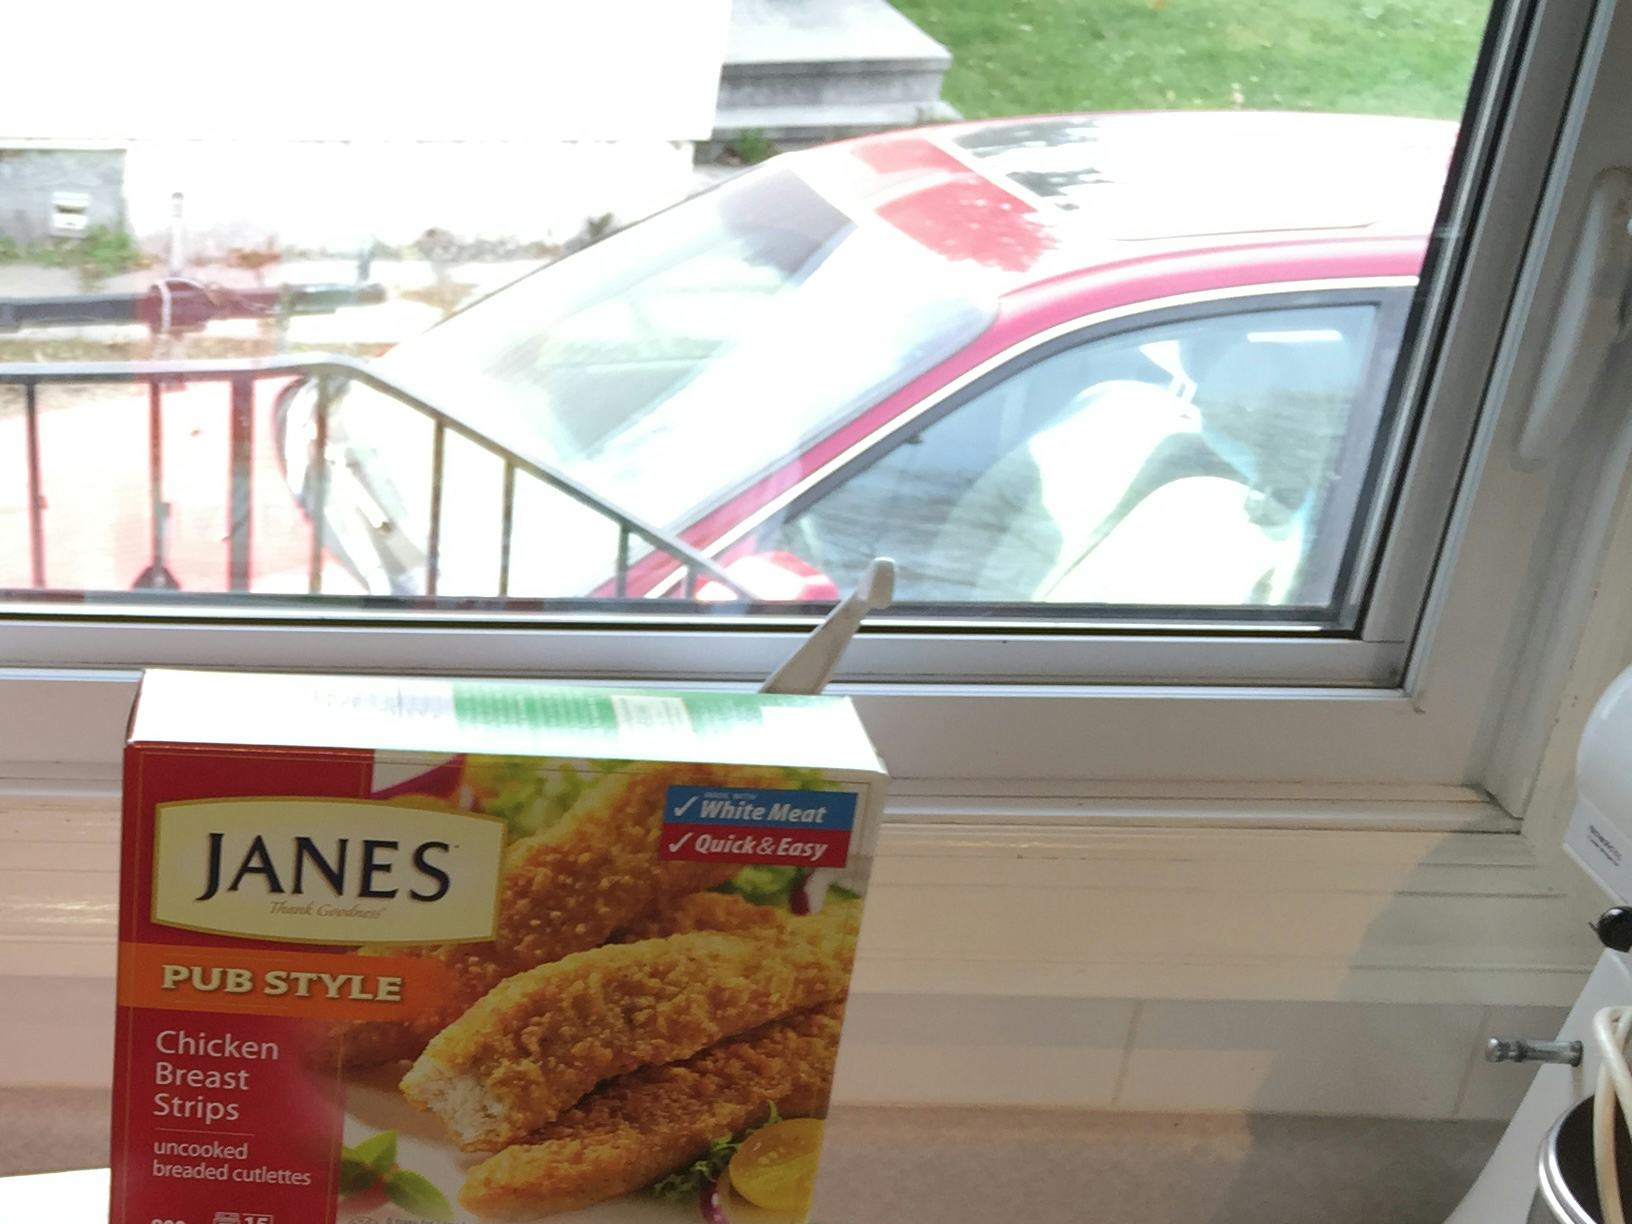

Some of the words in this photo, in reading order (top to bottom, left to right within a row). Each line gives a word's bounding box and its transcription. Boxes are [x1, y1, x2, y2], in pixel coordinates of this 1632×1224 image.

[699, 799, 768, 822] White
[768, 803, 826, 823] Meat
[195, 832, 452, 902] JANES
[269, 900, 313, 917] Thank
[317, 903, 383, 920] Goodness
[160, 964, 253, 993] PUB
[263, 970, 402, 1002] STYLE
[155, 1030, 279, 1061] Chicken
[154, 1061, 251, 1091] Breast
[153, 1093, 240, 1125] Strips
[153, 1141, 248, 1161] uncooked
[152, 1159, 229, 1181] breaded
[231, 1165, 312, 1186] cutlettes
